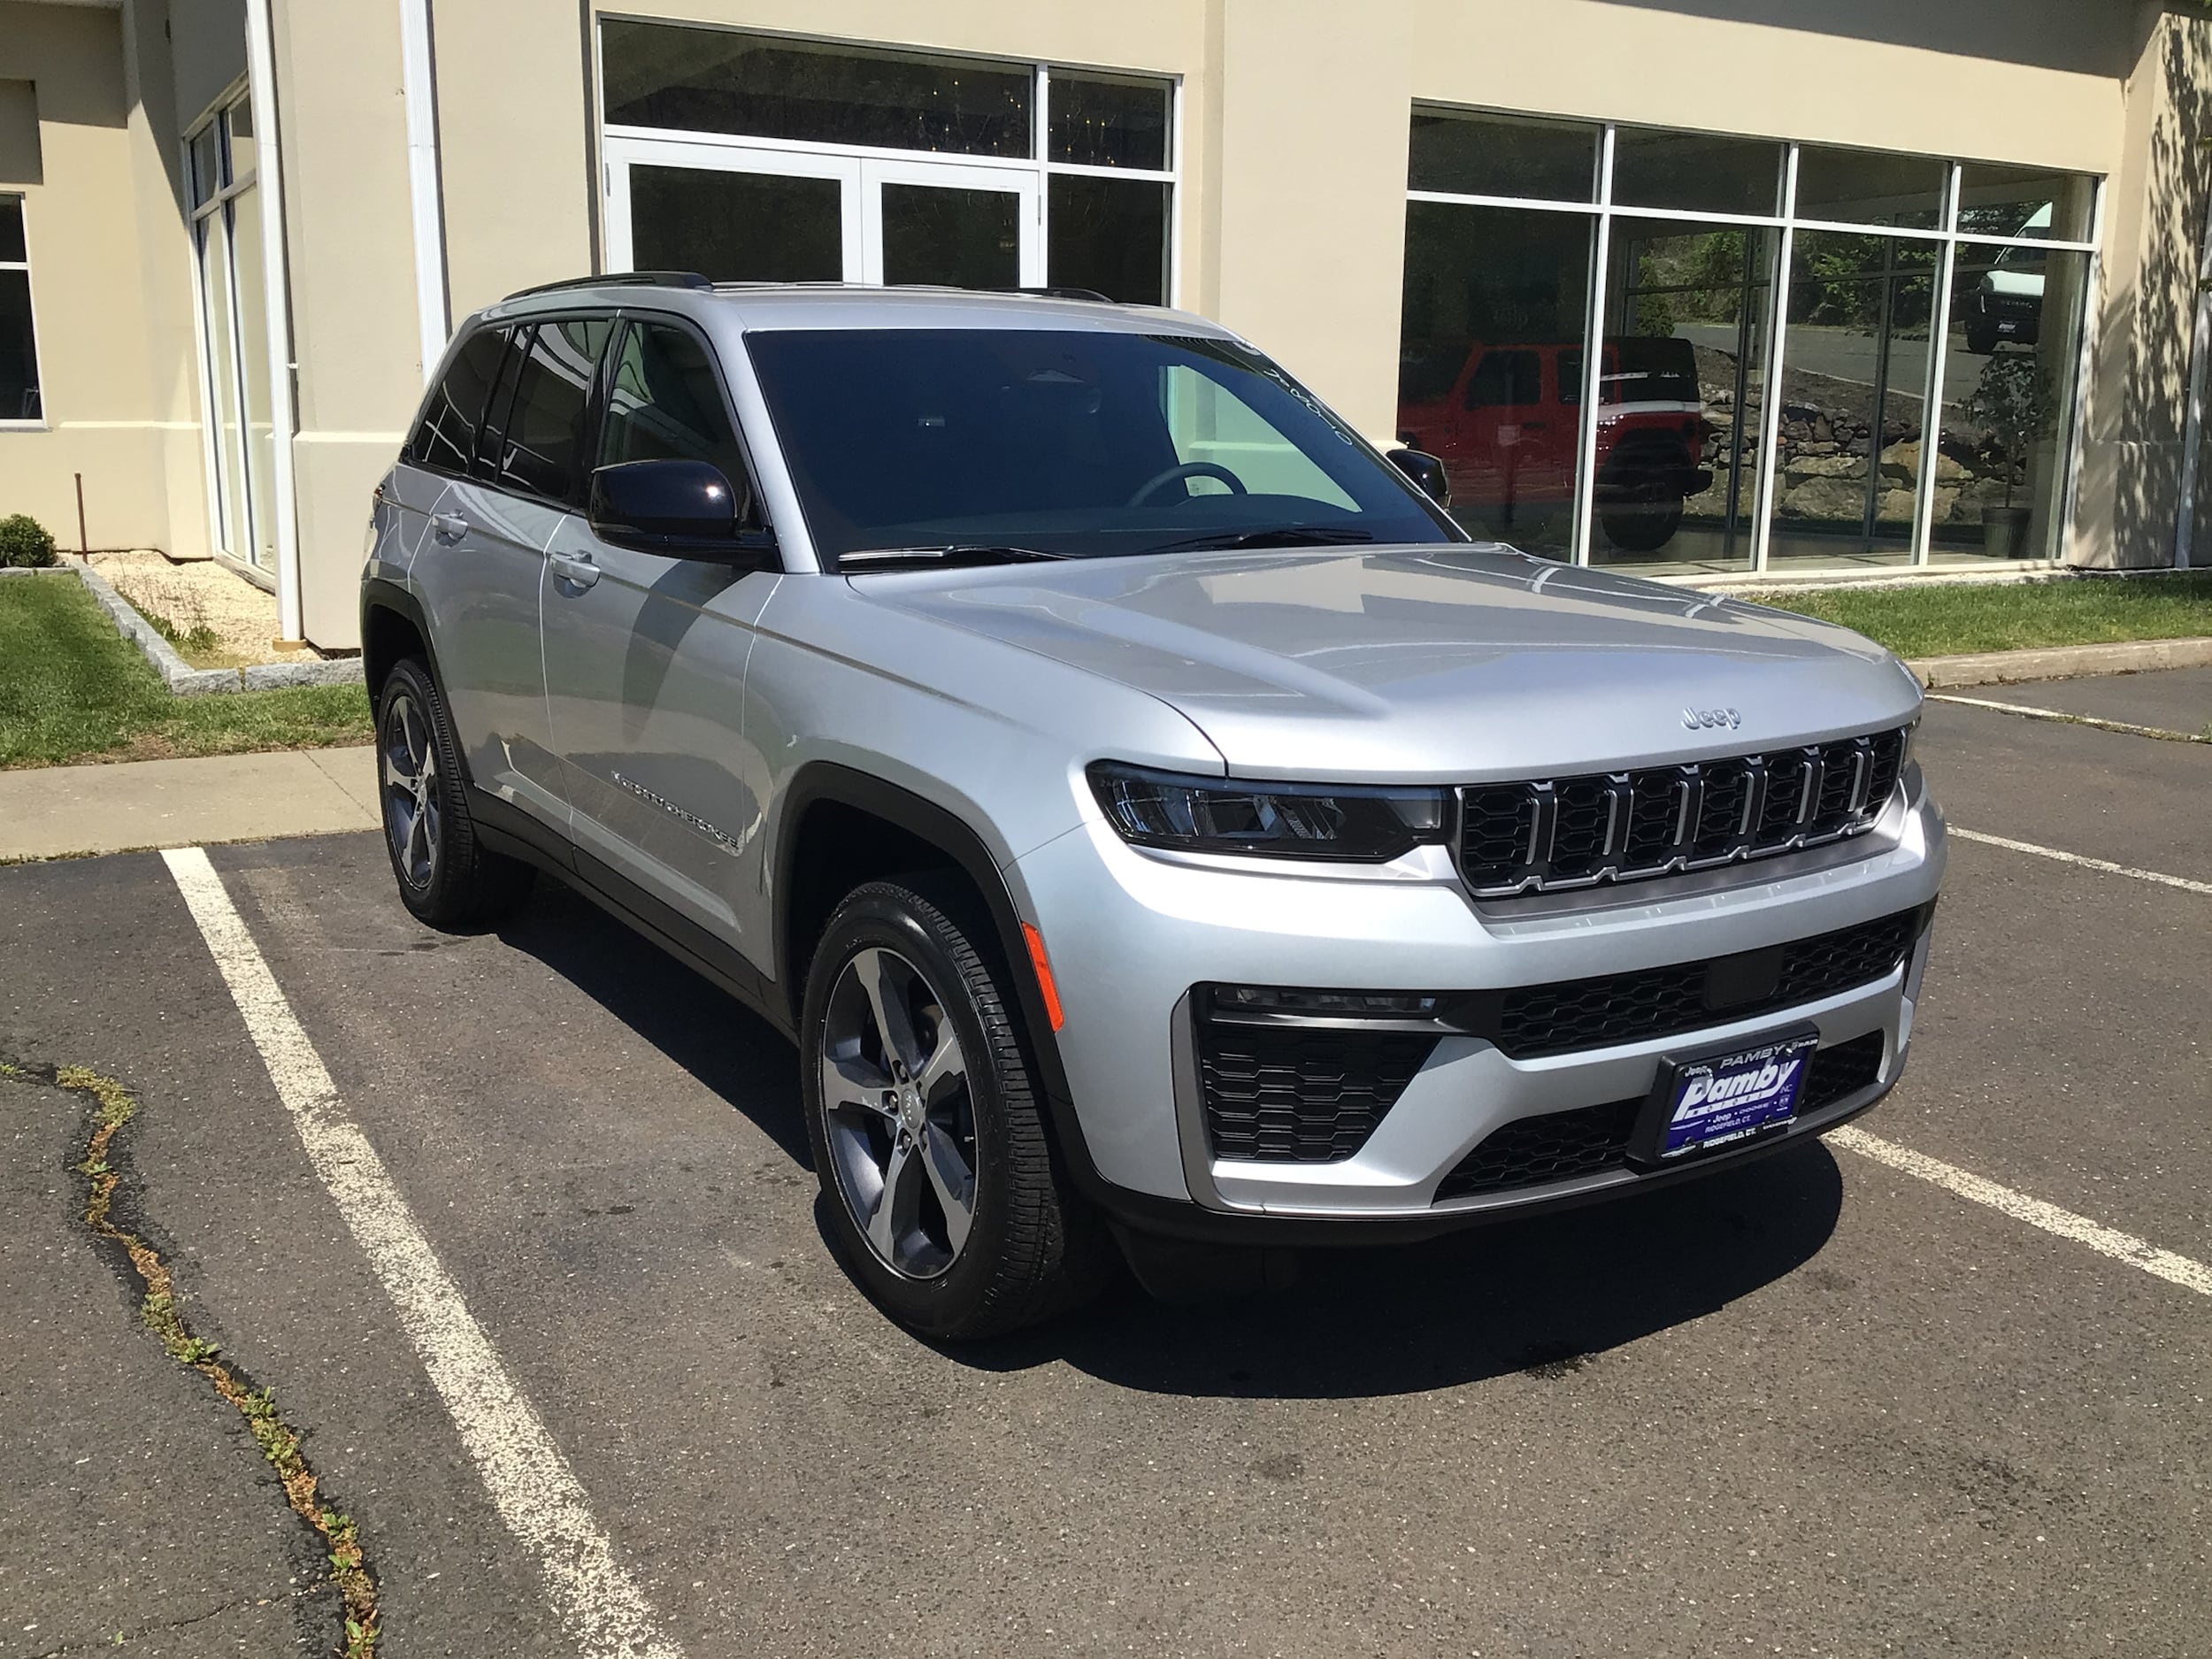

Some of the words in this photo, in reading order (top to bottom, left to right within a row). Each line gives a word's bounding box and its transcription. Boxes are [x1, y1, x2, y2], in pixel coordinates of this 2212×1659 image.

[1681, 707, 1741, 730] Jeep
[1719, 1044, 1786, 1069] PAMBY
[1671, 1056, 1801, 1124] Pamby
[1713, 1113, 1732, 1124] Jeep
